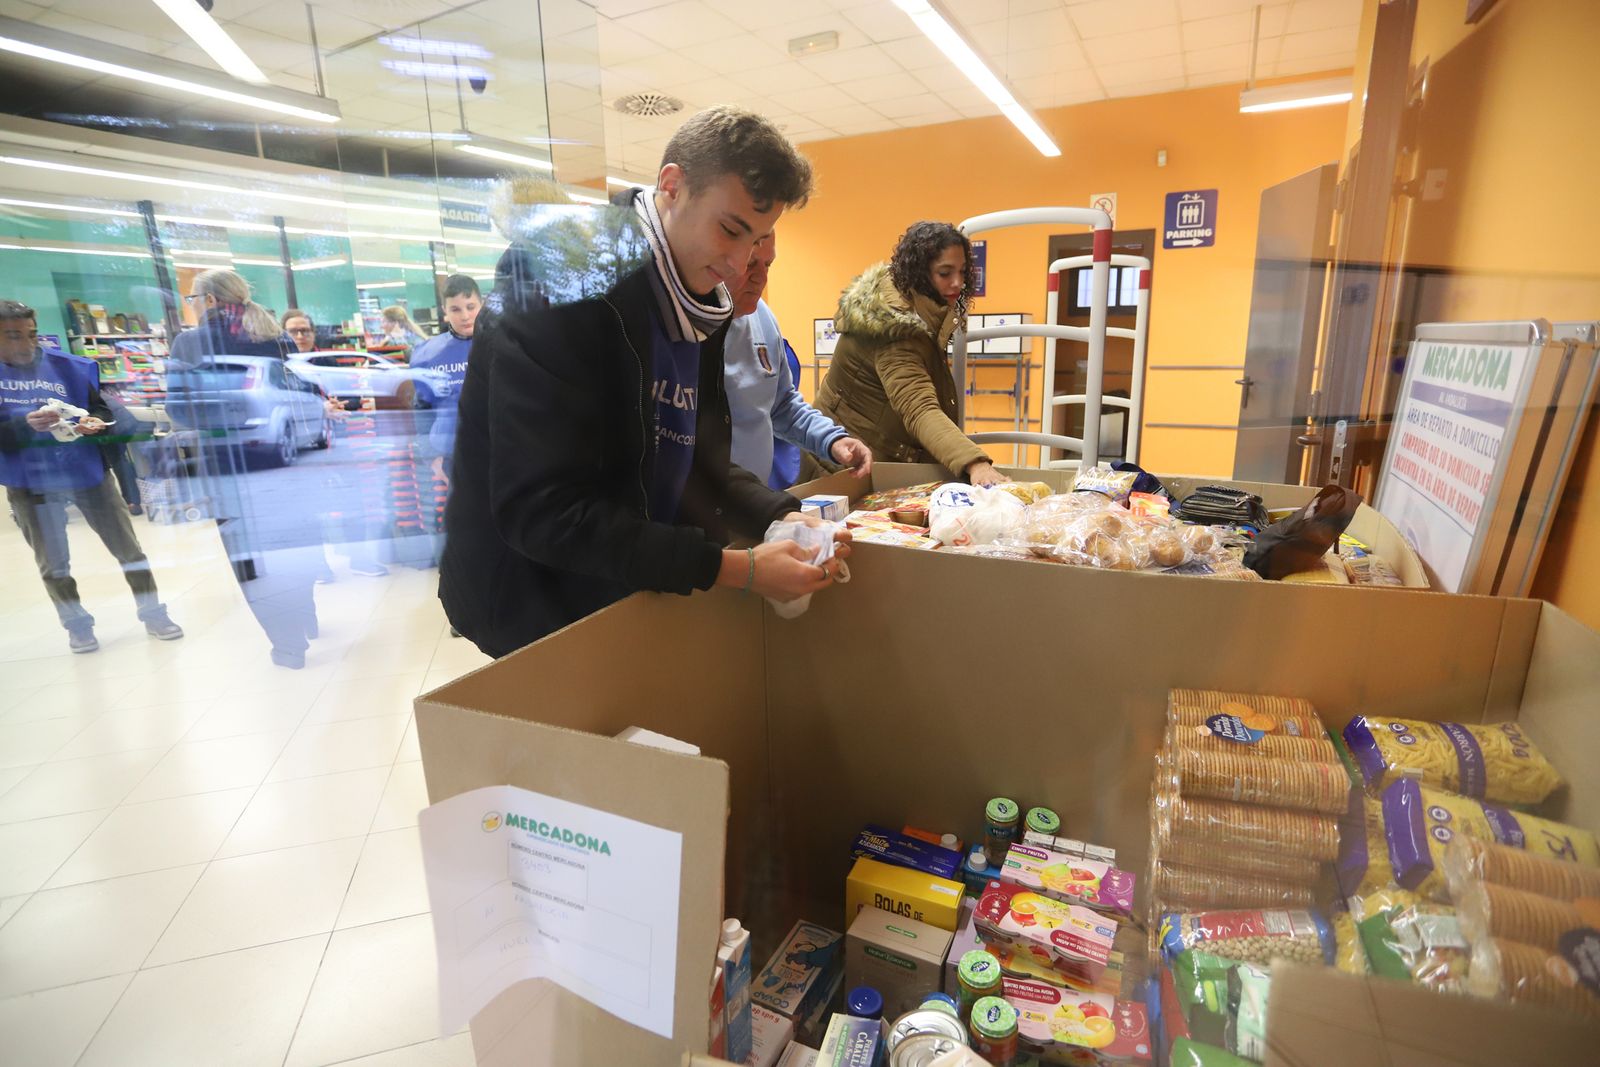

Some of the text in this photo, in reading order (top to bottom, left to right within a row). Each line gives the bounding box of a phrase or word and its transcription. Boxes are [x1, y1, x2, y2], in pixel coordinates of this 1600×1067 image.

[1166, 228, 1213, 239] PARKING
[1422, 346, 1512, 391] MERCADONA
[506, 812, 612, 857] MERCADONA
[1011, 845, 1047, 859] CINCO FRUTAS
[874, 892, 912, 919] BOLAS
[913, 911, 924, 921] DE
[1018, 984, 1034, 993] FRUTAS
